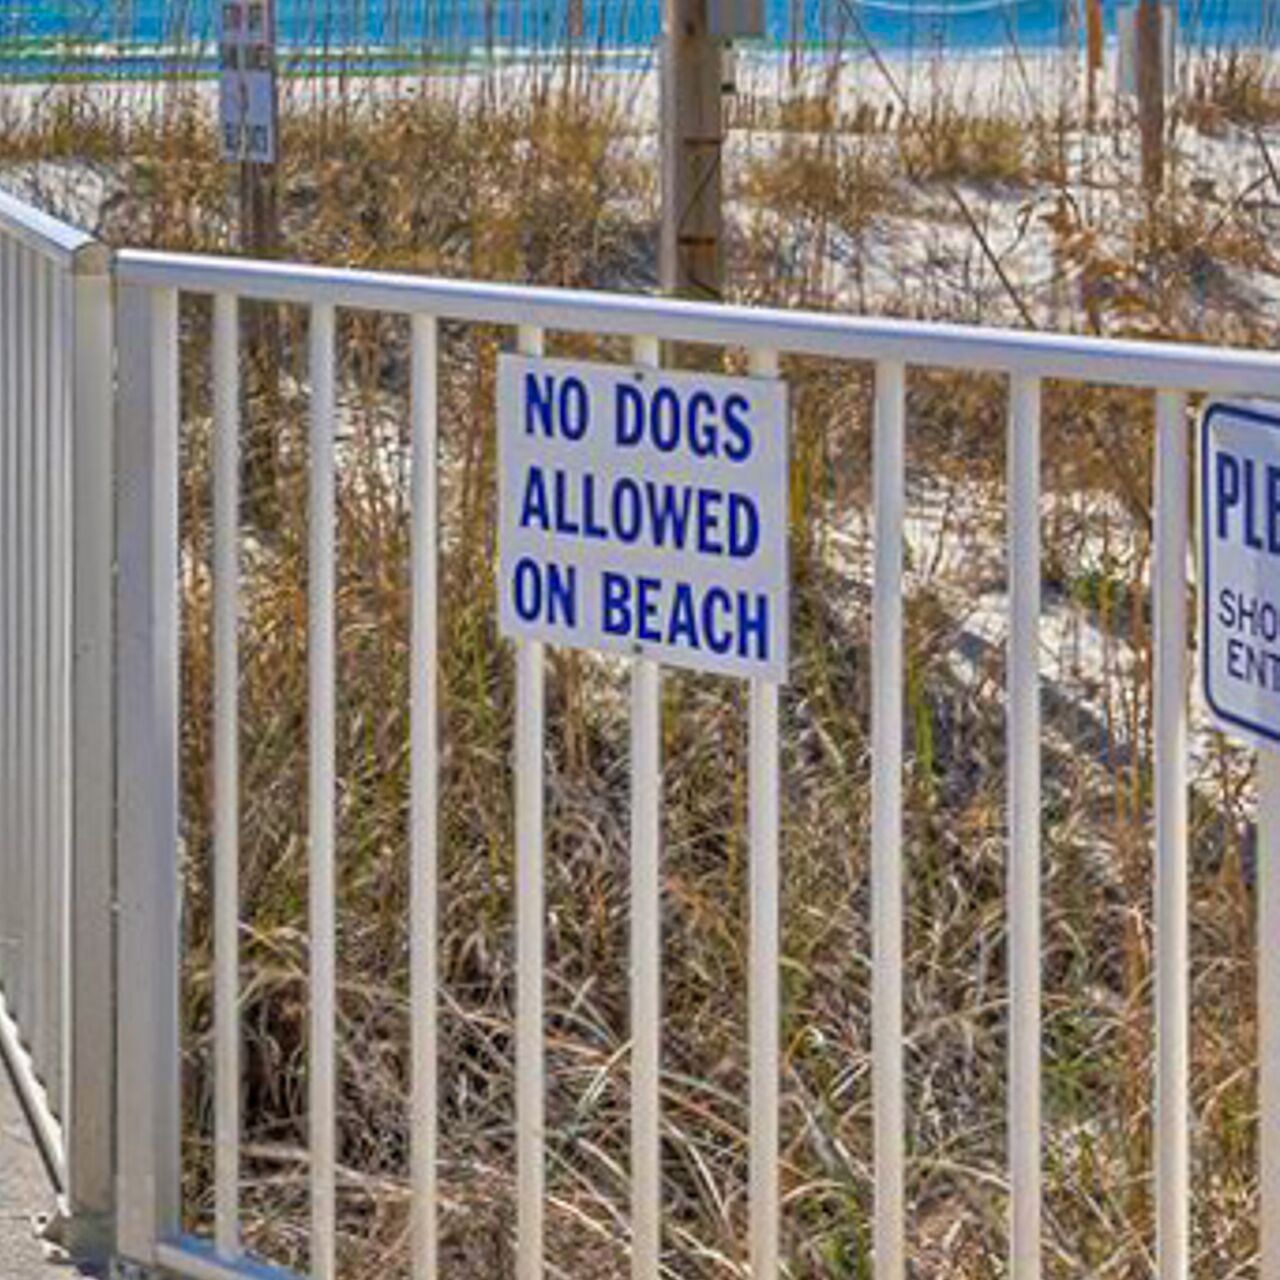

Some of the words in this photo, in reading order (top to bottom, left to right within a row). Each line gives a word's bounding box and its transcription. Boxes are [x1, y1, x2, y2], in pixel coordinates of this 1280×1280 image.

[525, 373, 589, 441] NO
[615, 383, 753, 462] DOGS
[519, 466, 760, 558] ALLOWED
[513, 557, 577, 628] ON
[601, 571, 769, 660] BEACH
